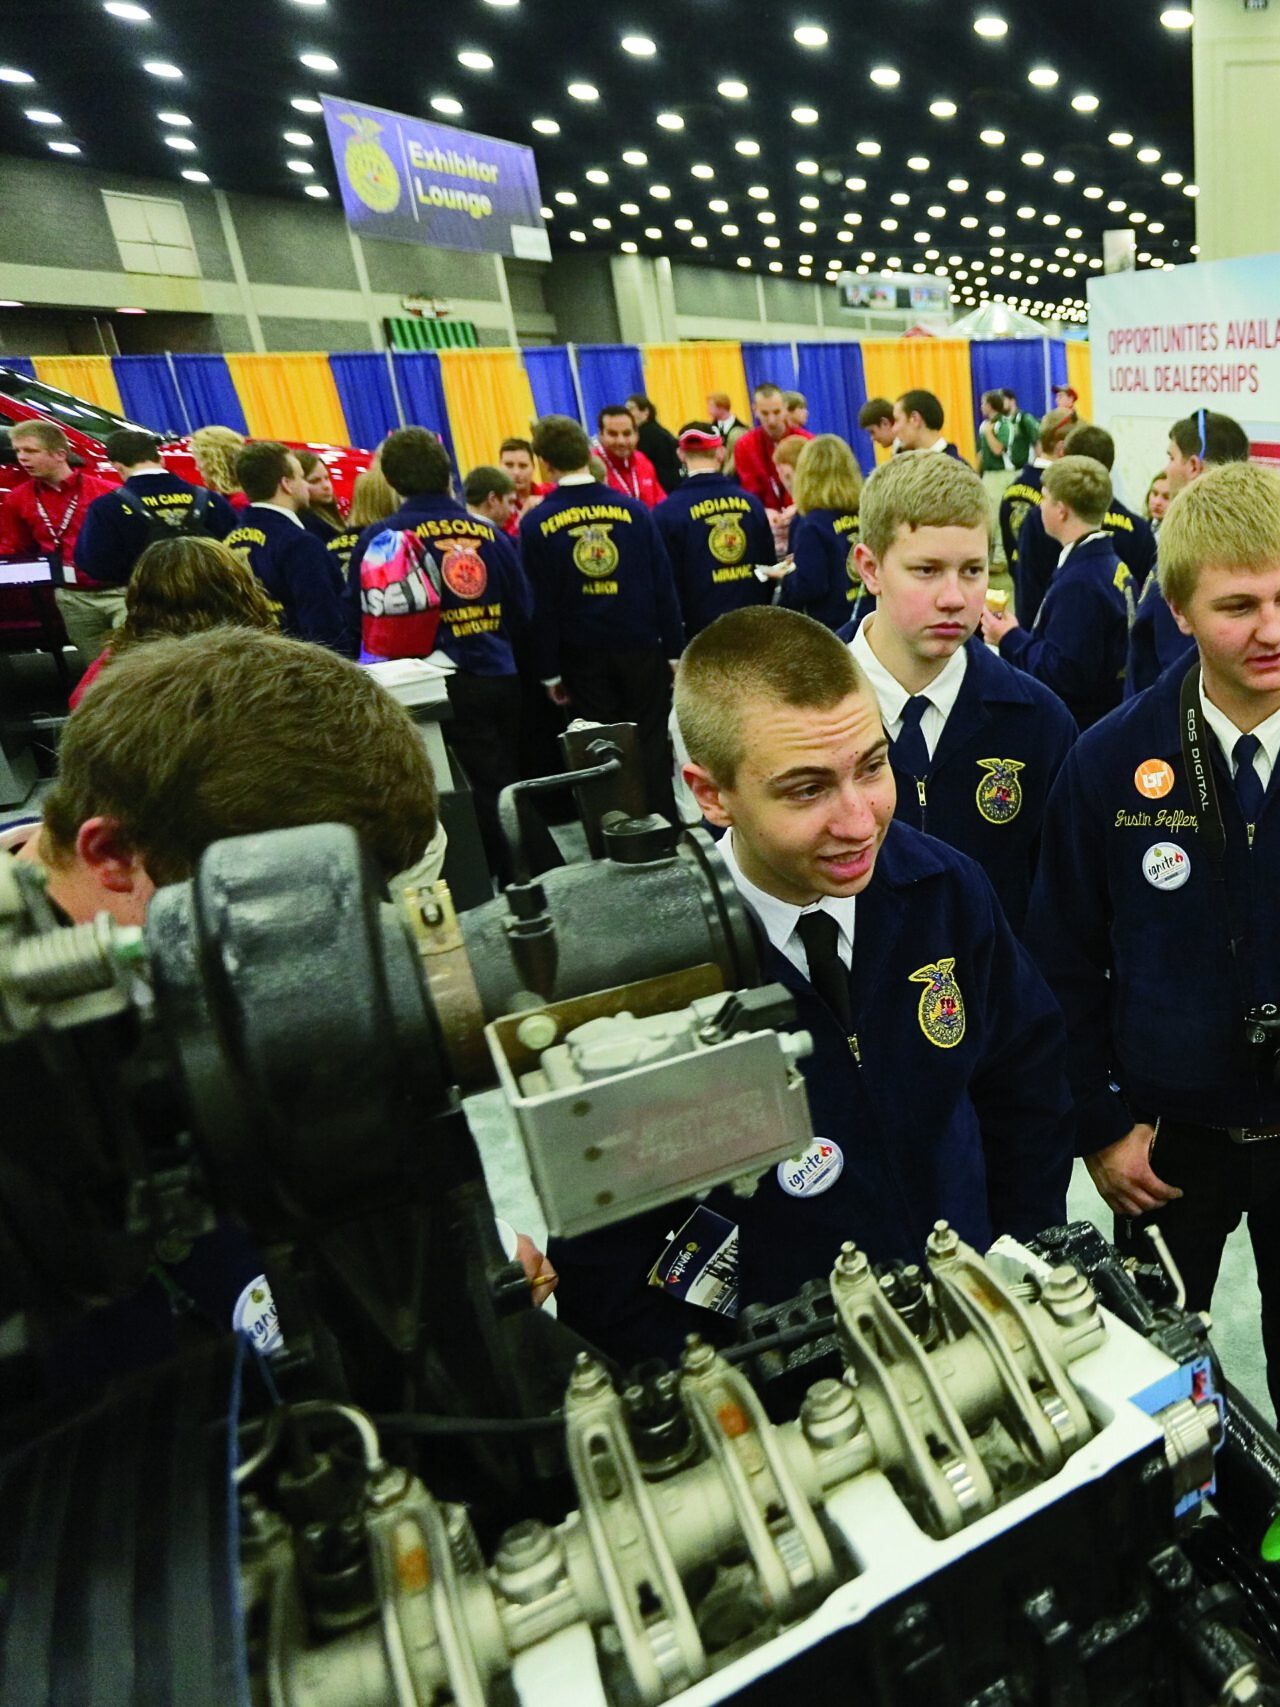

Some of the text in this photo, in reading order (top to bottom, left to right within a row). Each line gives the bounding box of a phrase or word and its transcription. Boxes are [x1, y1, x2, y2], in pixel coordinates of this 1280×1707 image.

[407, 139, 498, 185] Exhibitor
[414, 175, 493, 220] Lounge
[1107, 323, 1218, 355] OPPORTUNITIES
[1109, 363, 1259, 393] LOCAL DEALERSHIPS
[540, 504, 632, 538] PENNSYLVANIA
[690, 496, 752, 520] INDIANA
[415, 519, 496, 543] MISSOURI
[1187, 708, 1210, 811] EOS DIGITAL
[1114, 809, 1151, 827] Justin
[1148, 856, 1176, 881] ignite
[788, 1153, 823, 1190] ignite
[672, 1250, 694, 1277] ignite
